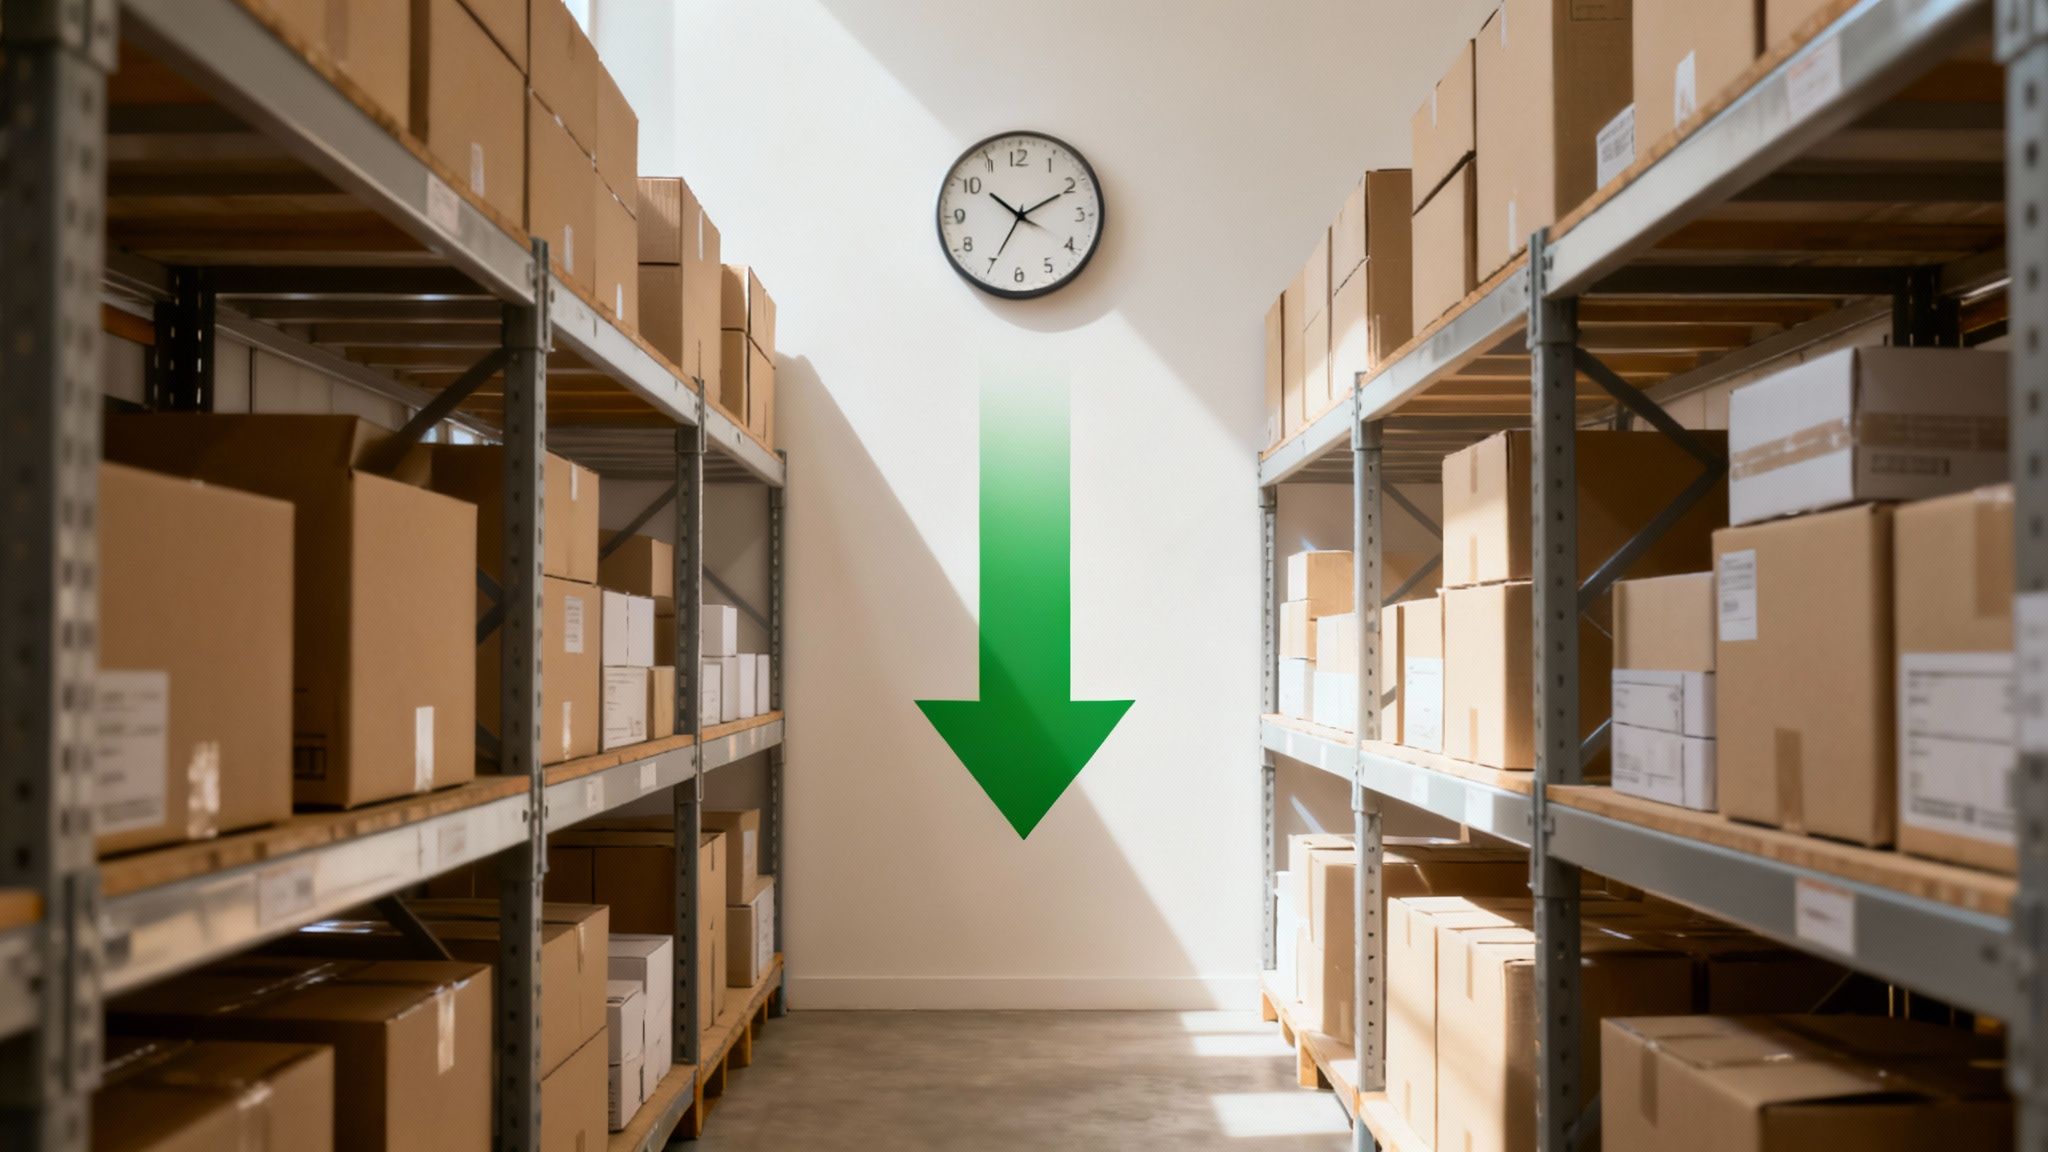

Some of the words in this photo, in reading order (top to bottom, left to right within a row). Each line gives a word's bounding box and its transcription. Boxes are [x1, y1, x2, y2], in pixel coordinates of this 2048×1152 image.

[1009, 149, 1029, 168] 12
[963, 176, 982, 194] 10
[1063, 176, 1076, 194] 2
[954, 208, 966, 224] 9
[1075, 207, 1086, 223] 3
[963, 236, 973, 252] 8
[1063, 236, 1075, 252] 4
[1044, 257, 1053, 274] 5
[1013, 267, 1025, 283] 6
